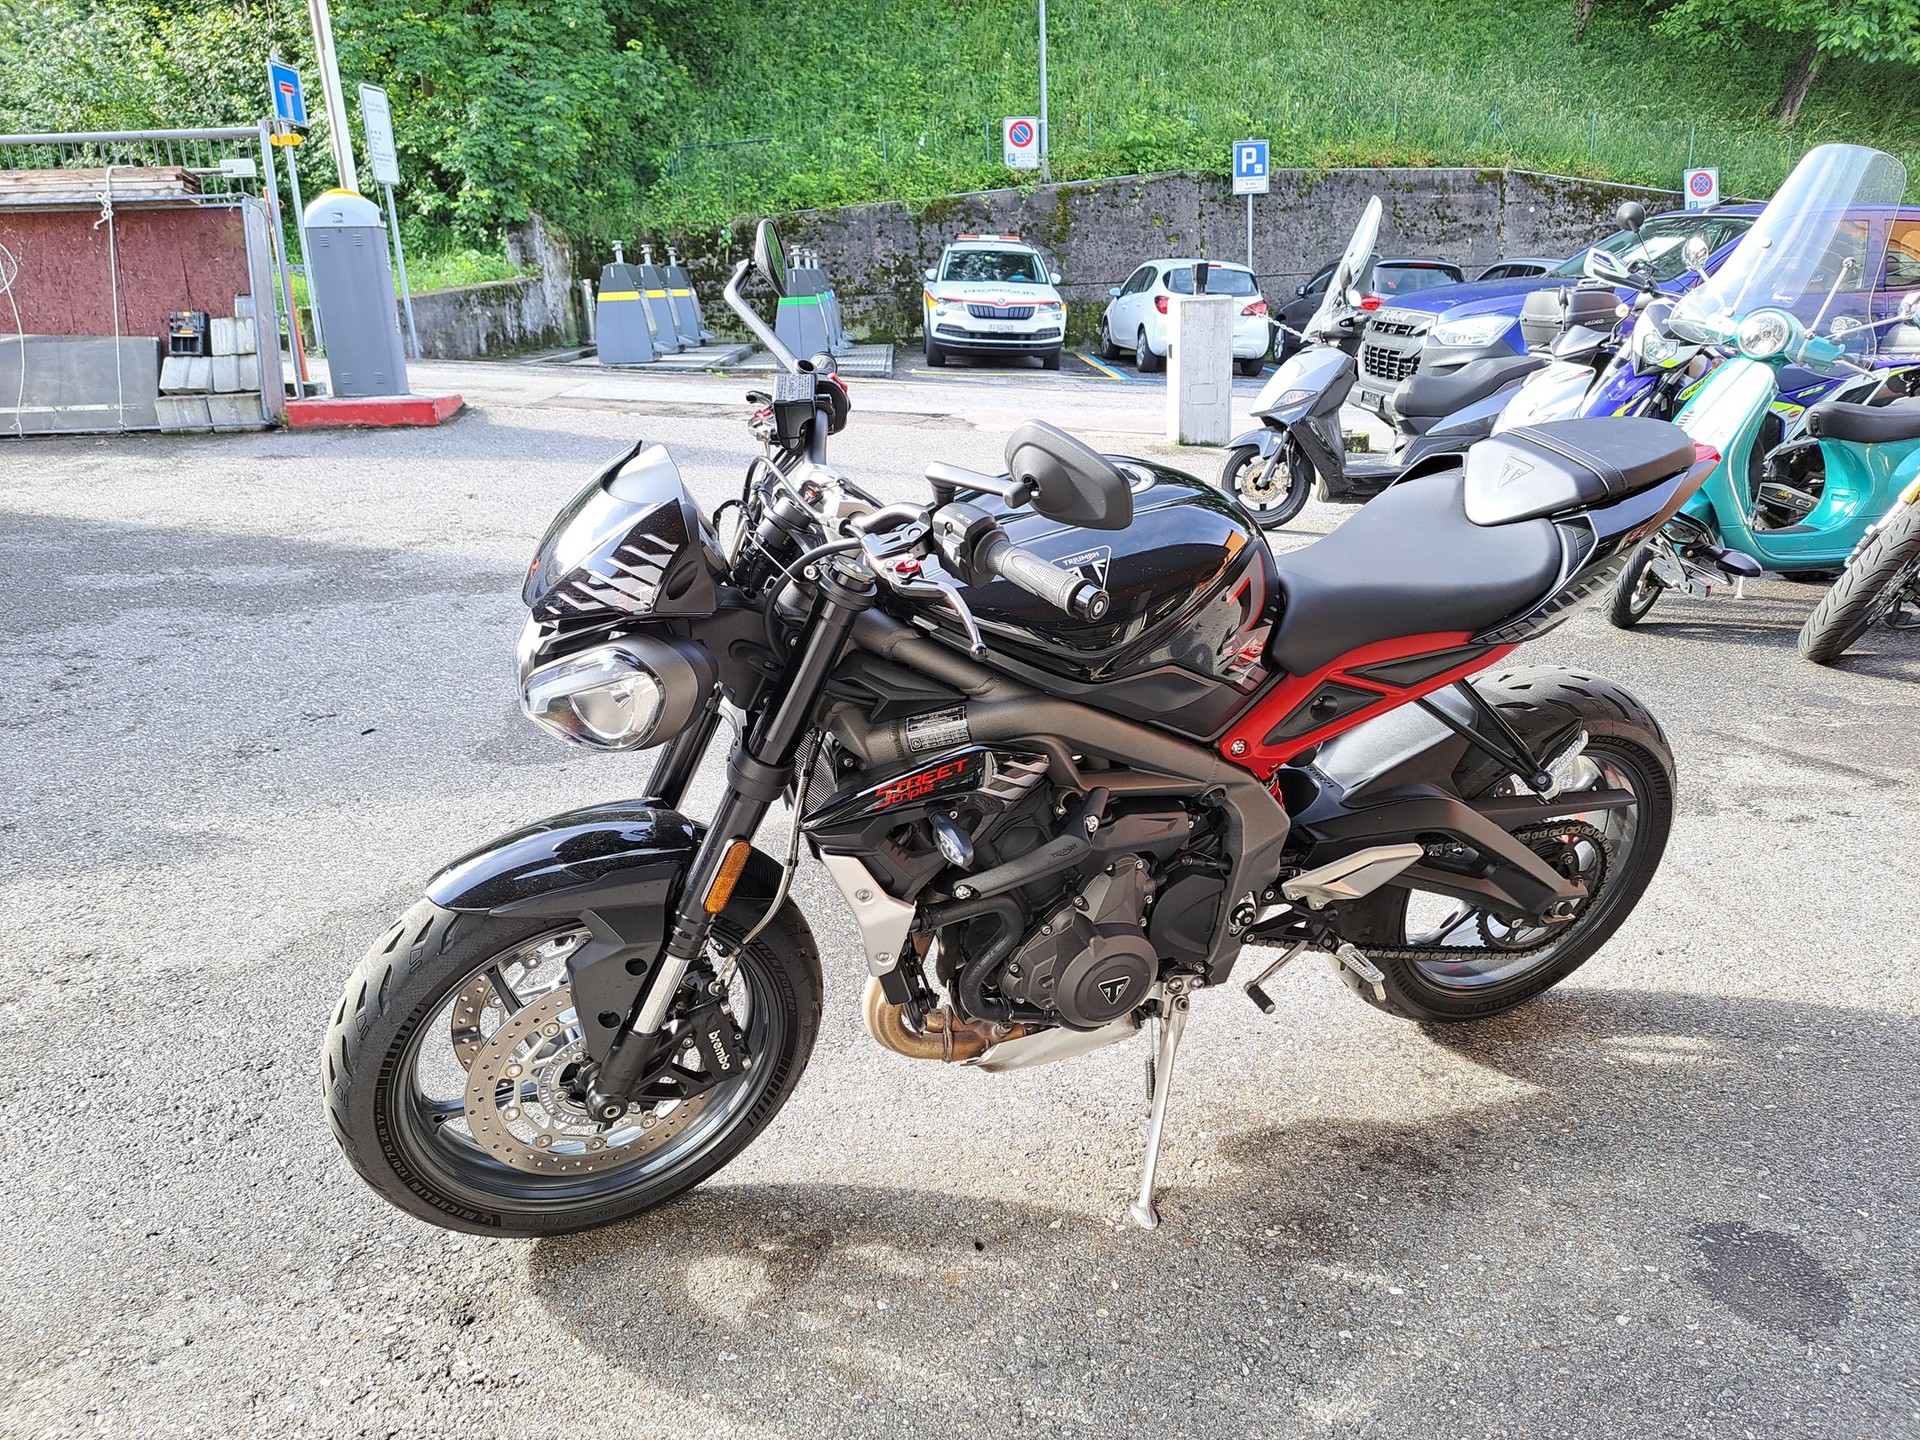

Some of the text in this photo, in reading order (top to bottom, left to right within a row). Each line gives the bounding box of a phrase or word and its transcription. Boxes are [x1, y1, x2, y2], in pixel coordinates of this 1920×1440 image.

[1241, 147, 1257, 173] P
[1062, 551, 1100, 566] TRIUMPH
[876, 758, 969, 797] STREET
[1051, 842, 1078, 859] TRIUMPH
[708, 1029, 731, 1070] brembo
[376, 1114, 385, 1127] 17
[379, 1128, 390, 1143] ZR
[384, 1144, 409, 1178] 120/70
[409, 1179, 478, 1222] MICHELIN
